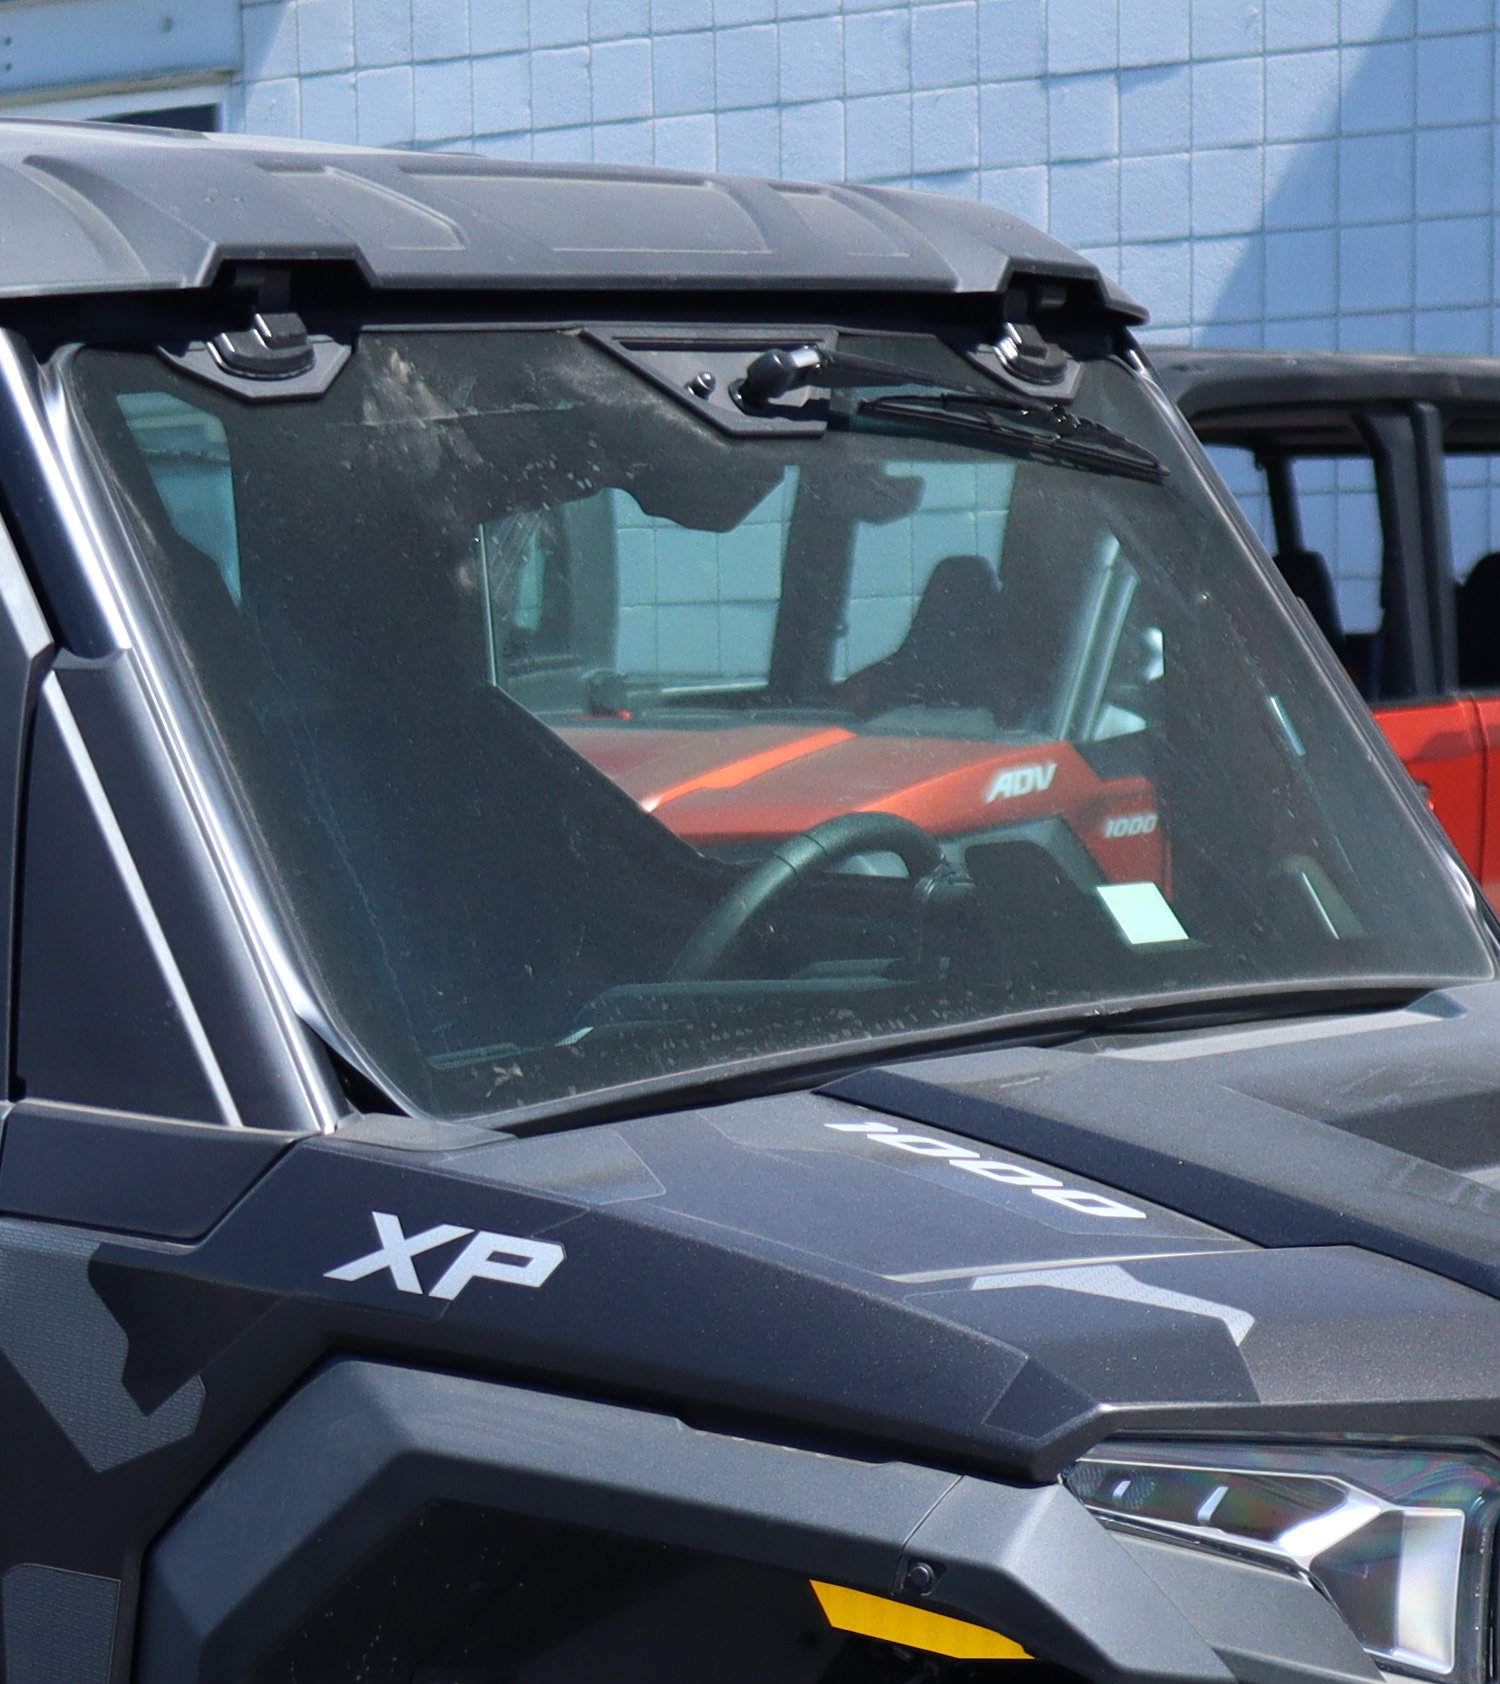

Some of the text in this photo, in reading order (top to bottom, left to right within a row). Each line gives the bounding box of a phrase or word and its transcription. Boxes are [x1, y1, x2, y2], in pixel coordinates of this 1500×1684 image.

[986, 762, 1058, 804] ADV
[1104, 813, 1158, 838] 1000
[824, 1122, 1147, 1218] 1000
[324, 1211, 566, 1301] XP
